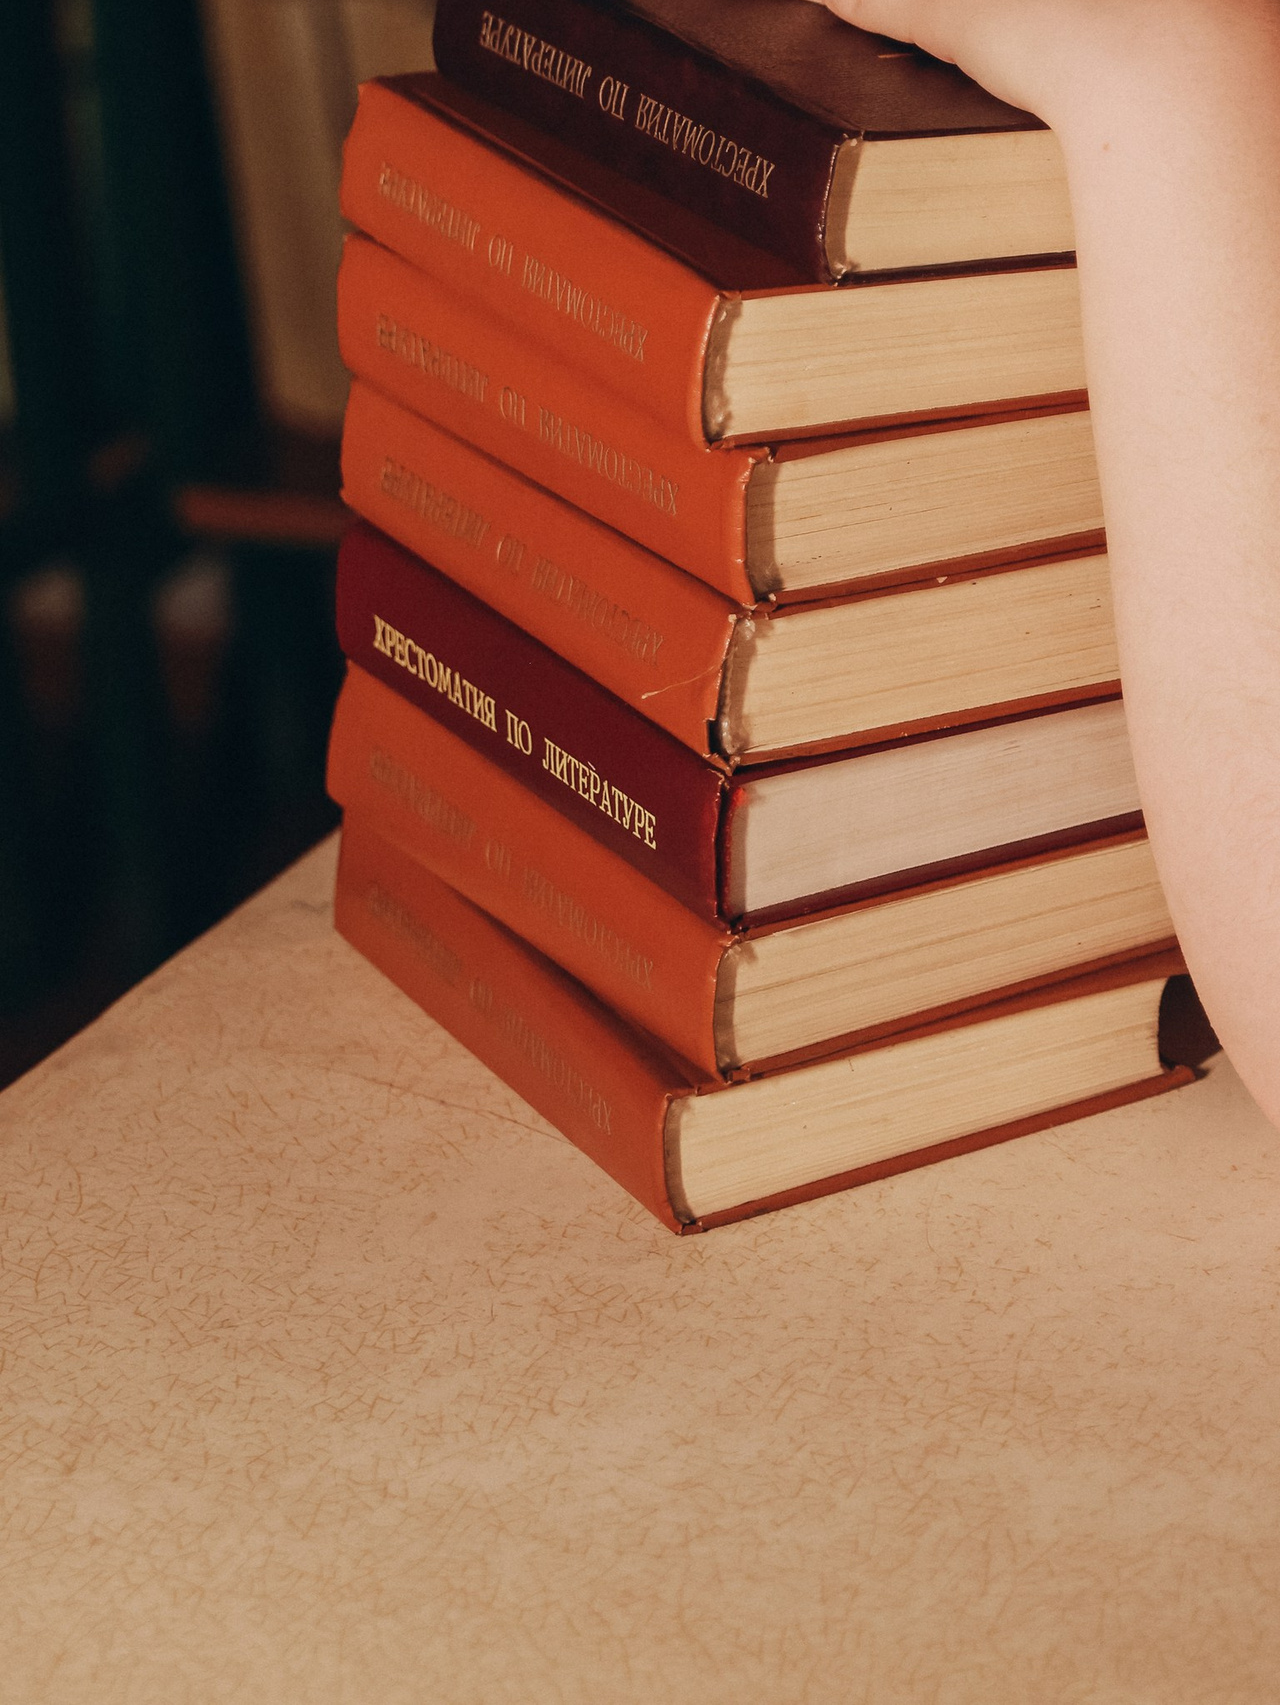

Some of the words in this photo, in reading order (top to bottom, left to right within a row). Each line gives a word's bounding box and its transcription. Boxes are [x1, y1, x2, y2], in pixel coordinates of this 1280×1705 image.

[478, 9, 594, 100] ЛИТЕРАТУРЕ
[597, 75, 631, 122] ПО
[634, 92, 776, 199] ХРЕСТОМАТИЯ
[487, 233, 515, 276] ПО
[520, 254, 650, 363] ХРЕСТОМАТИЯ
[498, 385, 527, 428] ПО
[537, 404, 681, 518] ХРЕСТОМАТИЯ
[372, 613, 499, 734] ХРЕСТОМАТИЯ
[504, 708, 534, 756] ПО
[541, 737, 658, 851] ЛИТЕРАТУРЕ
